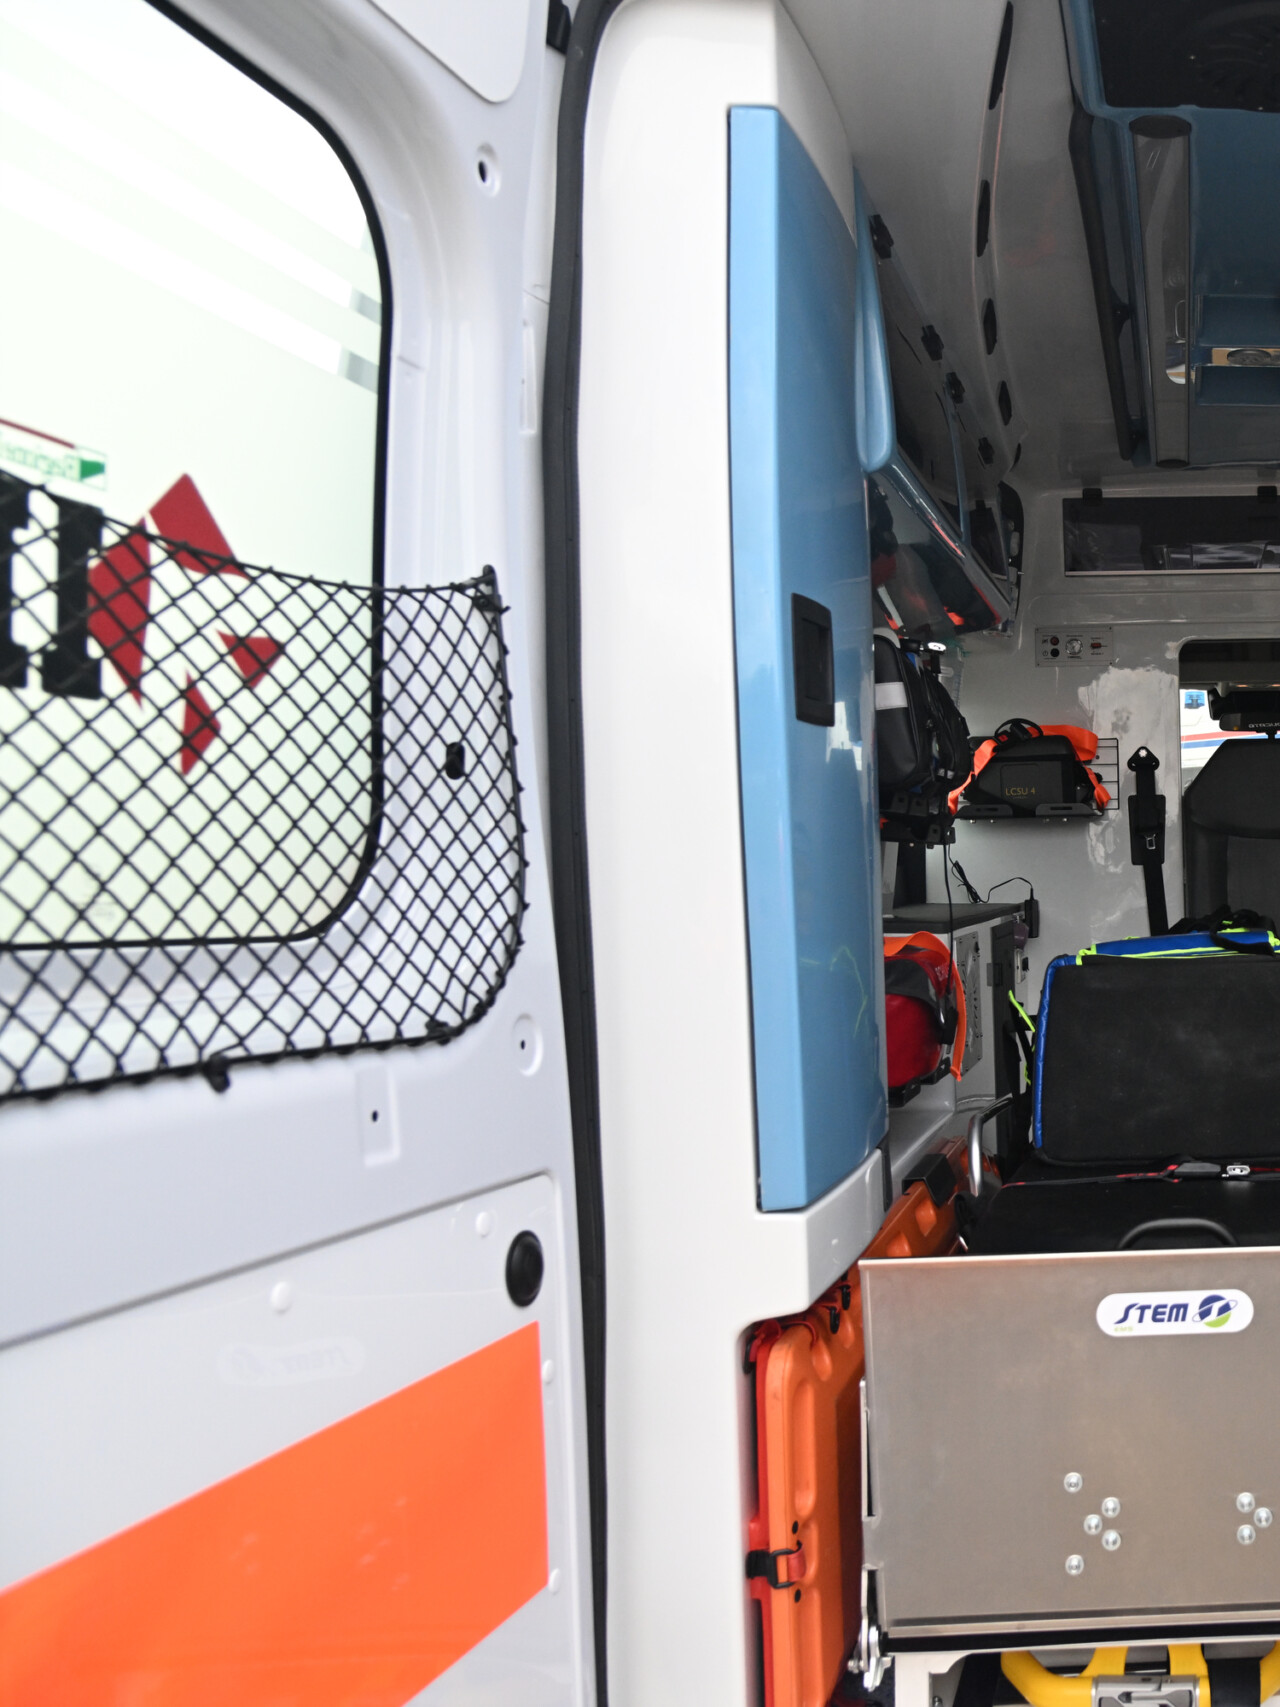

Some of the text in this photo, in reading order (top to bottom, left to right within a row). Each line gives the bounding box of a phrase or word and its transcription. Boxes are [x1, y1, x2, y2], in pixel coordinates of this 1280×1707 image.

[1005, 786, 1036, 796] LCSU 4
[1113, 1302, 1190, 1325] STEM
